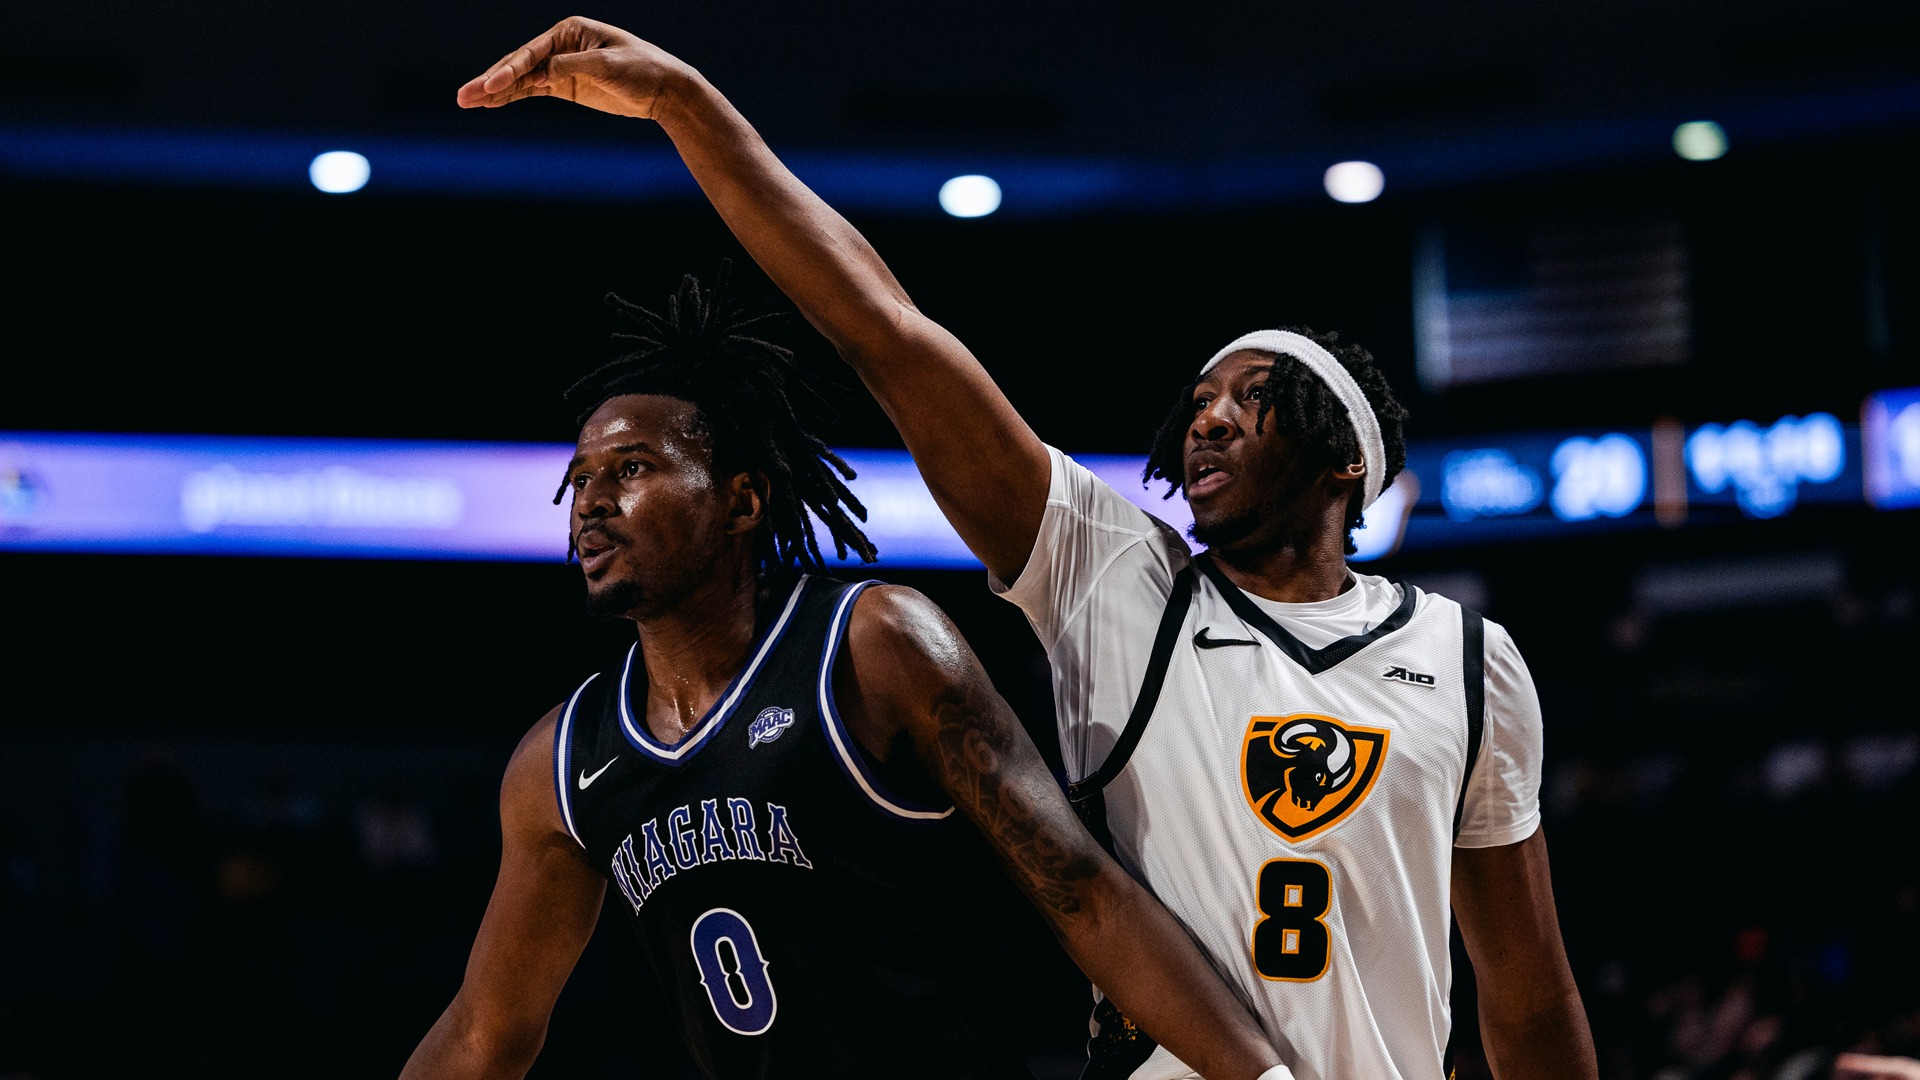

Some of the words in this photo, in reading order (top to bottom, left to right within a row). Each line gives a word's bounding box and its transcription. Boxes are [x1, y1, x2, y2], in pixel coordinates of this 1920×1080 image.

[749, 709, 795, 748] MAAC
[1382, 665, 1435, 686] A10
[611, 797, 813, 916] NIAGARA
[690, 907, 777, 1035] 0
[1251, 856, 1332, 983] 8
